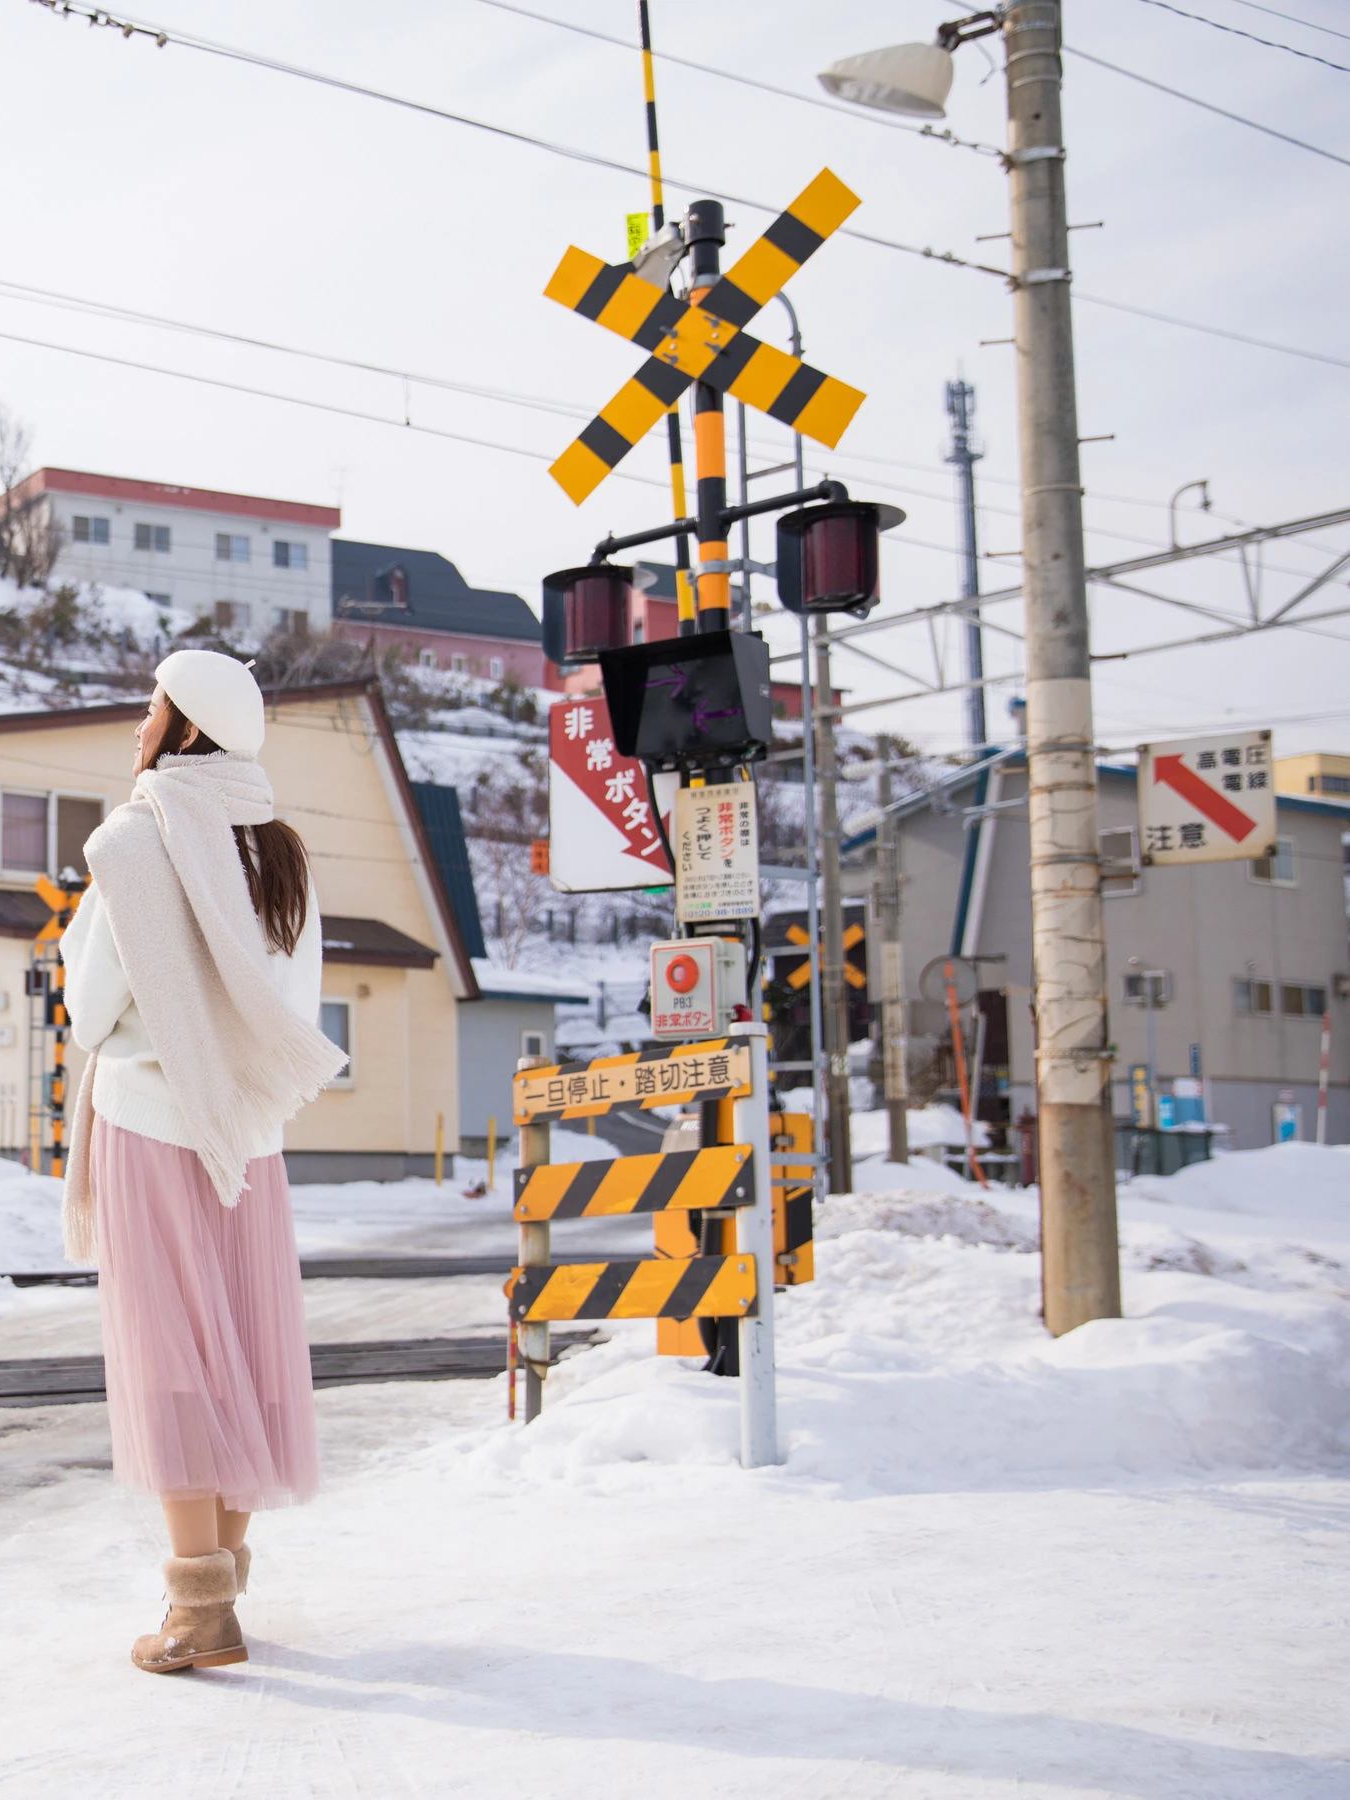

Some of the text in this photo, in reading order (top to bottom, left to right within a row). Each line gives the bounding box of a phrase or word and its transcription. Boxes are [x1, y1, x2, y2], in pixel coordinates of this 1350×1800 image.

[1197, 743, 1266, 770] 高電圧
[564, 706, 662, 856] 非常ボタン
[1222, 771, 1267, 792] 電線
[695, 806, 711, 860] つよく押して
[1146, 822, 1207, 851] 注意
[682, 830, 692, 872] ください
[655, 1010, 712, 1027] 非常ボタン
[524, 1054, 731, 1107] 一旦停止・踏切注意
